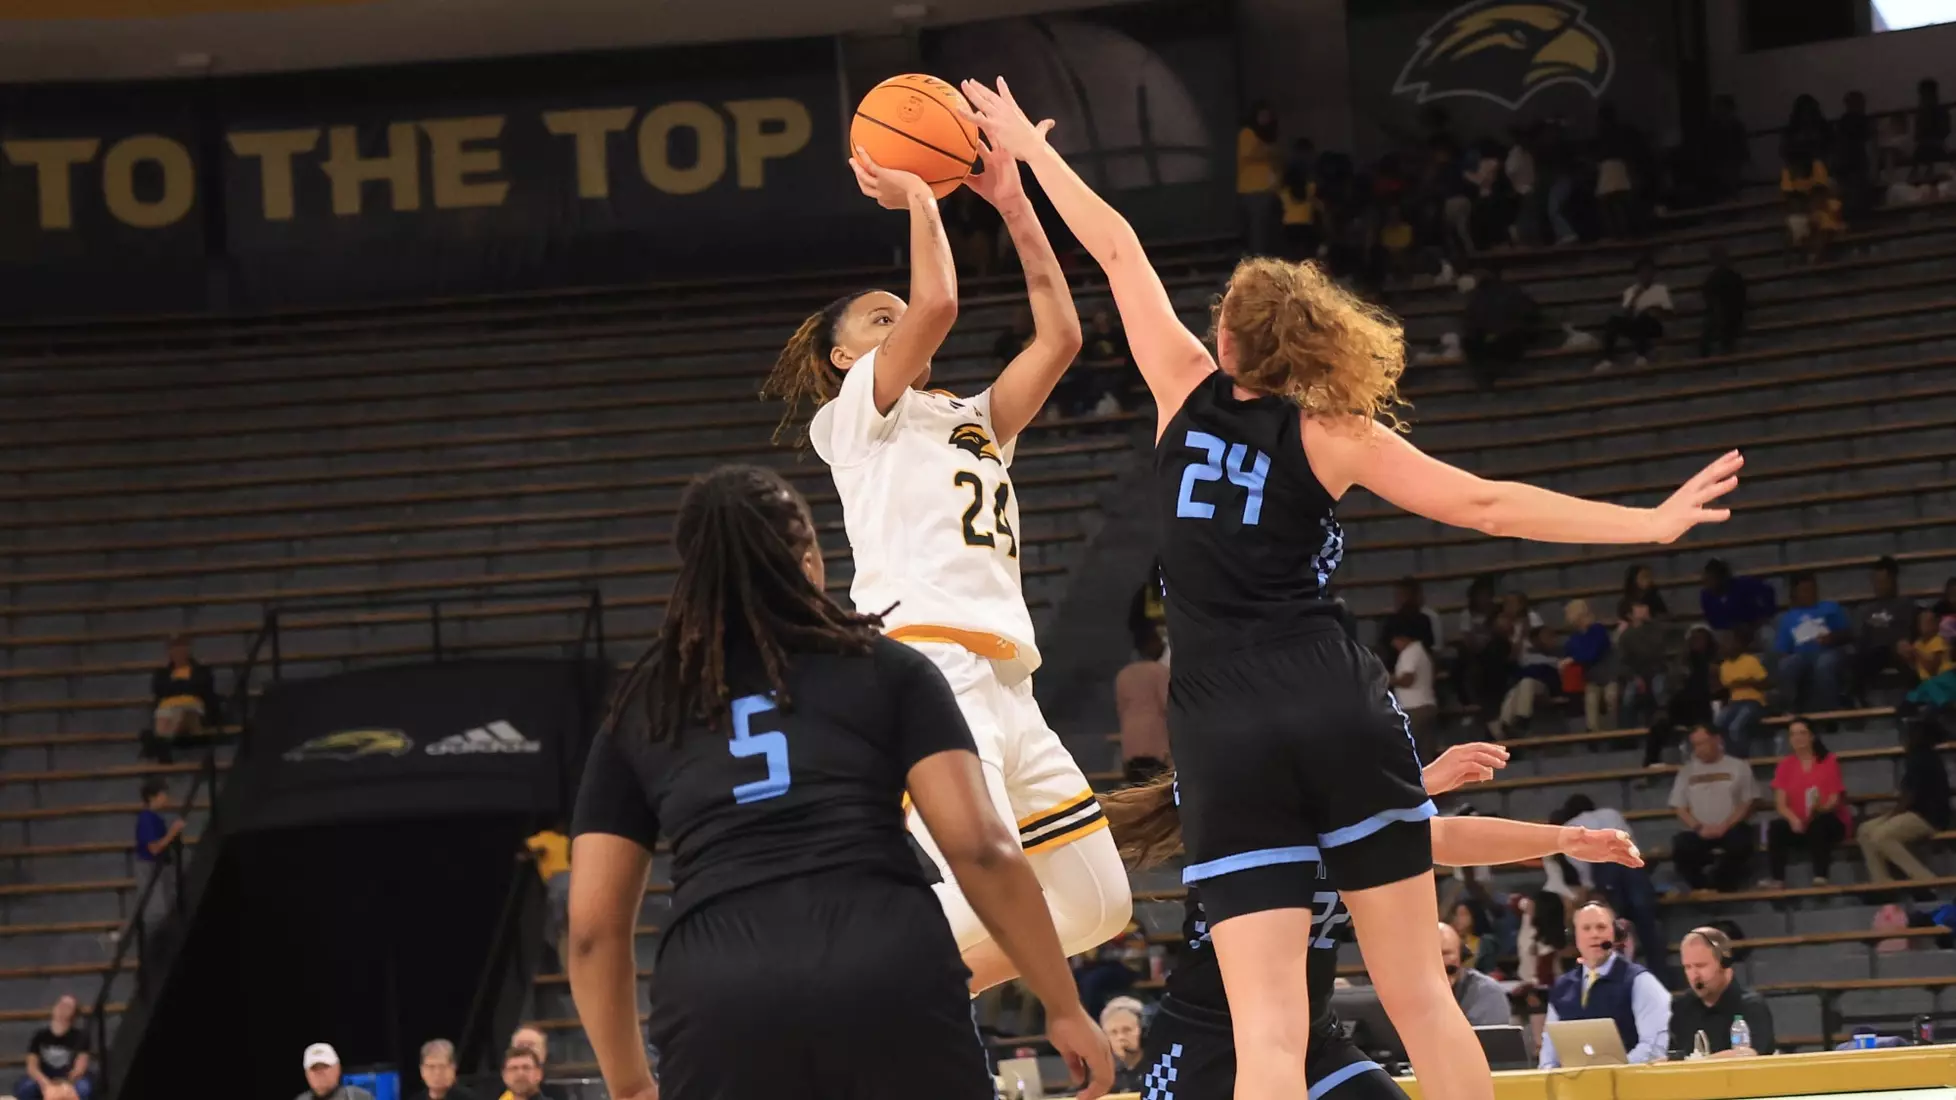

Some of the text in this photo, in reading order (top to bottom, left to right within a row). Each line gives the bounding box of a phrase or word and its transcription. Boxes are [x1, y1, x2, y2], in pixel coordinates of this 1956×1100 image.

[3, 98, 812, 229] TO THE TOP
[955, 471, 1017, 559] 24
[1177, 430, 1271, 524] 24
[729, 694, 791, 804] 5
